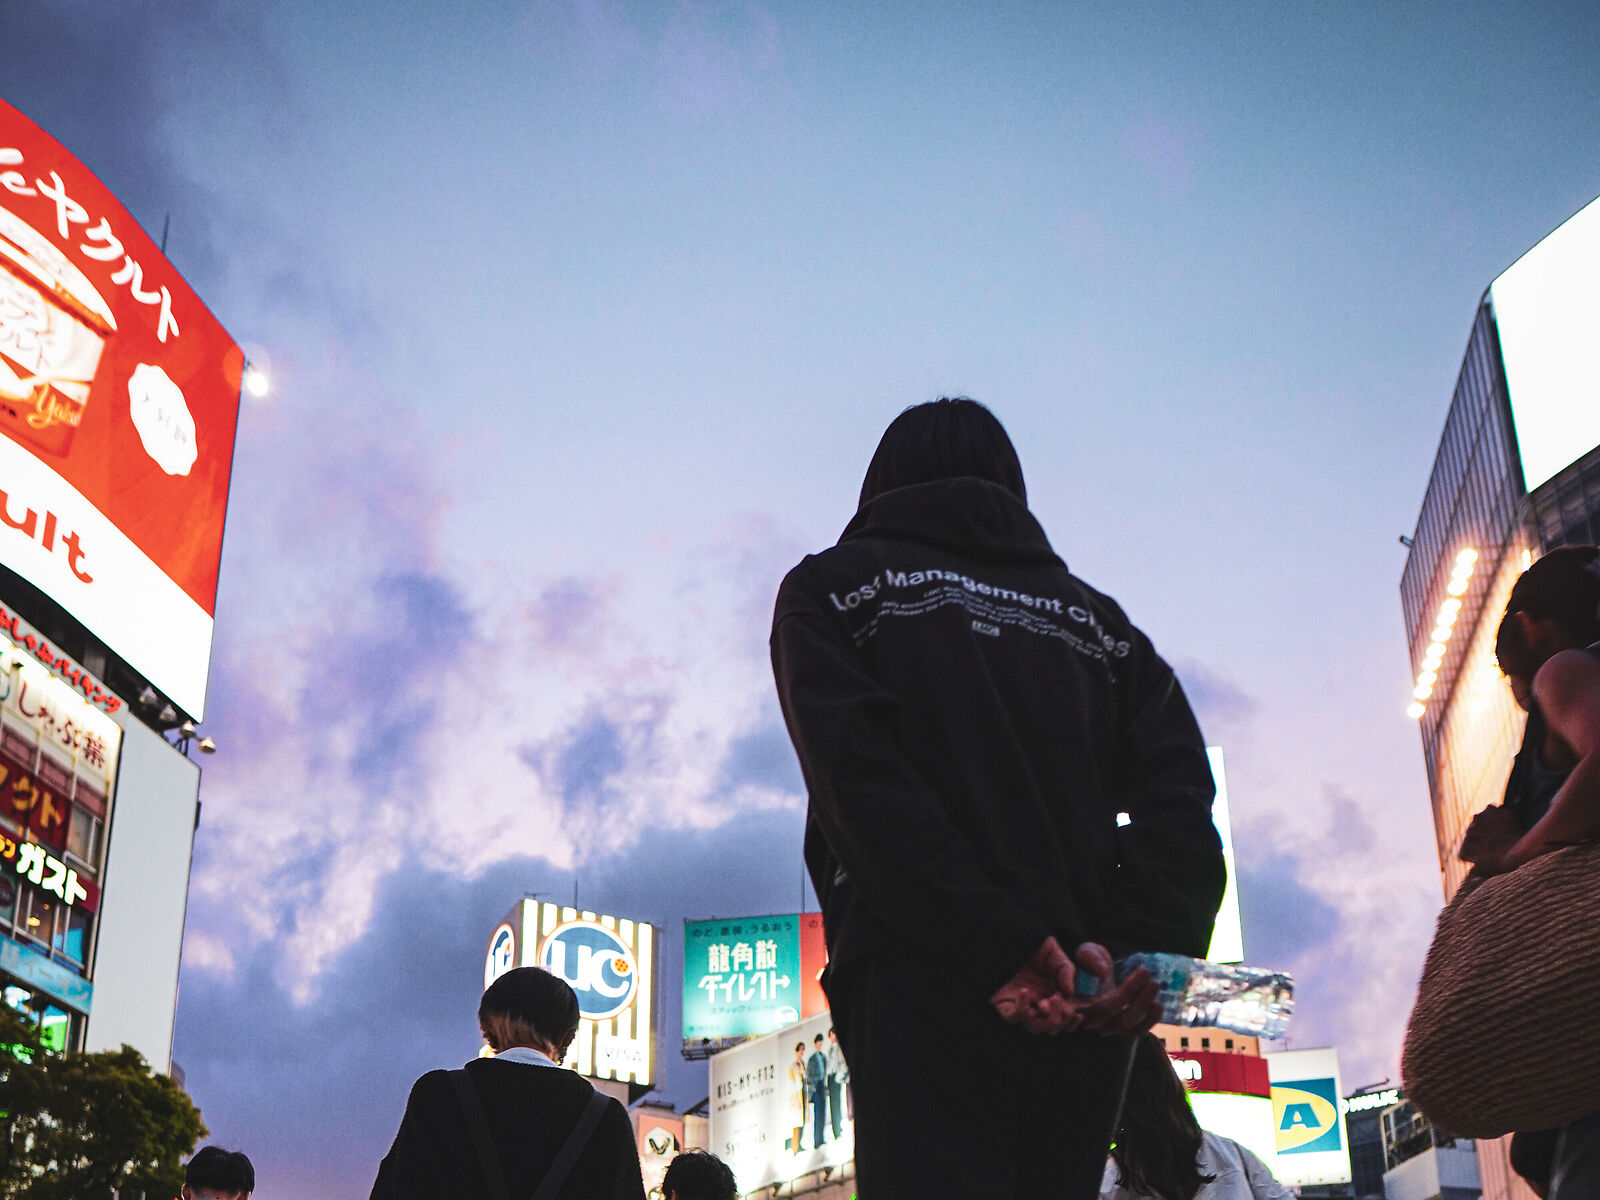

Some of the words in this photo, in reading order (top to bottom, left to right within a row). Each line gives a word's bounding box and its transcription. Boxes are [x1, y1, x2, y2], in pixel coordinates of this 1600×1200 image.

[0, 488, 93, 584] ult
[886, 569, 1063, 615] Management
[19, 680, 105, 769] しゃぶ葉
[16, 841, 87, 906] ガスト
[708, 939, 778, 973] 龍角散
